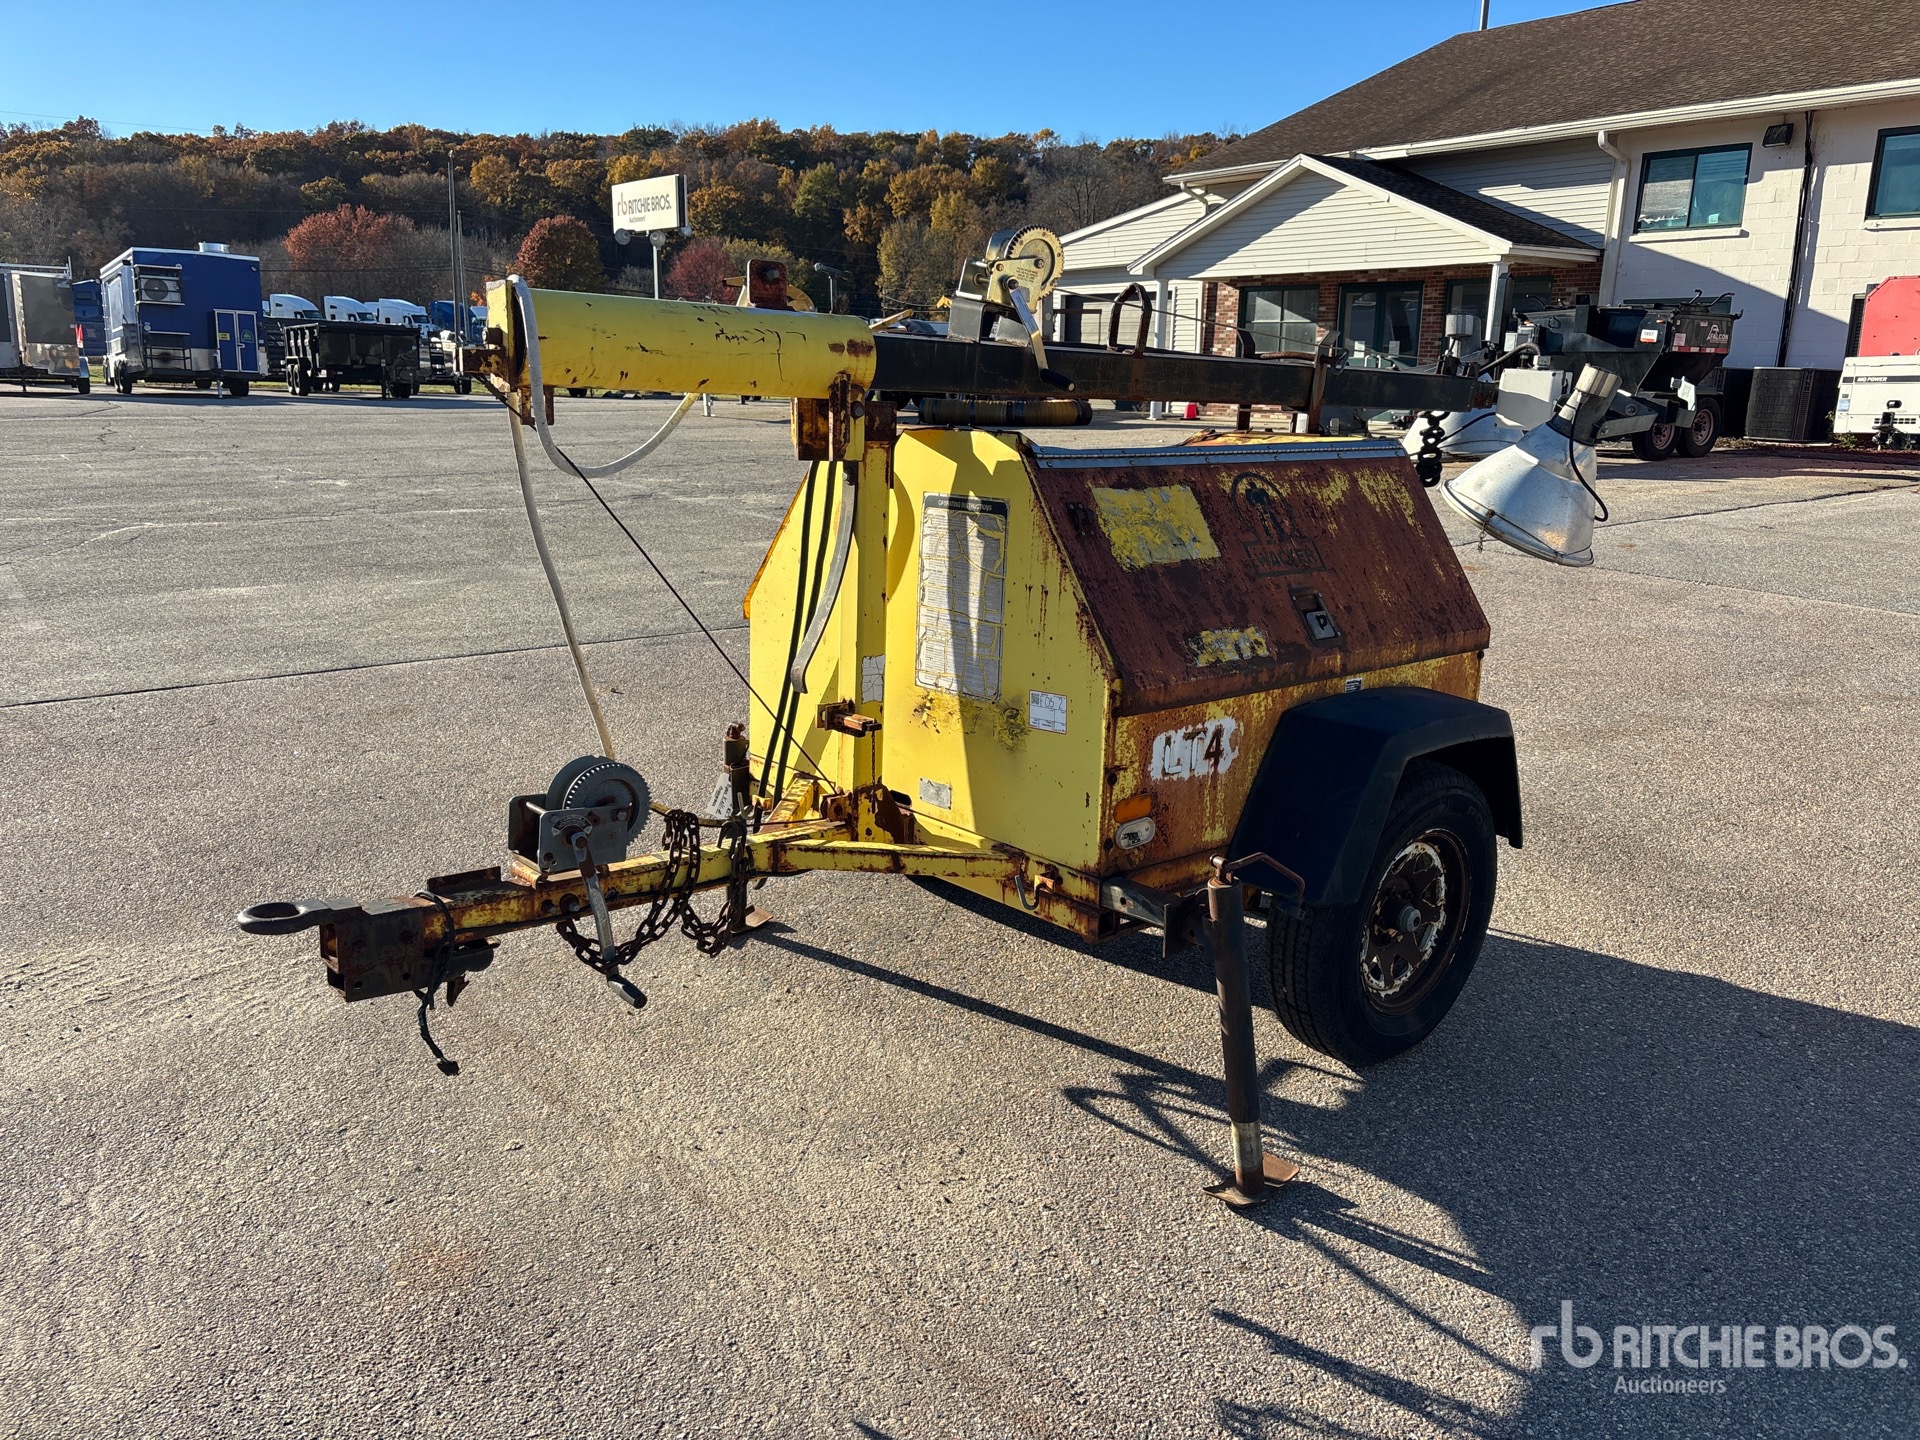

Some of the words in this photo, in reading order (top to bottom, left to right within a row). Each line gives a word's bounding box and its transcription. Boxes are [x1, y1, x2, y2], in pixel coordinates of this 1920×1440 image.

[628, 197, 650, 215] RITCHIE
[651, 194, 672, 211] BROS.
[1256, 547, 1317, 567] WACKER
